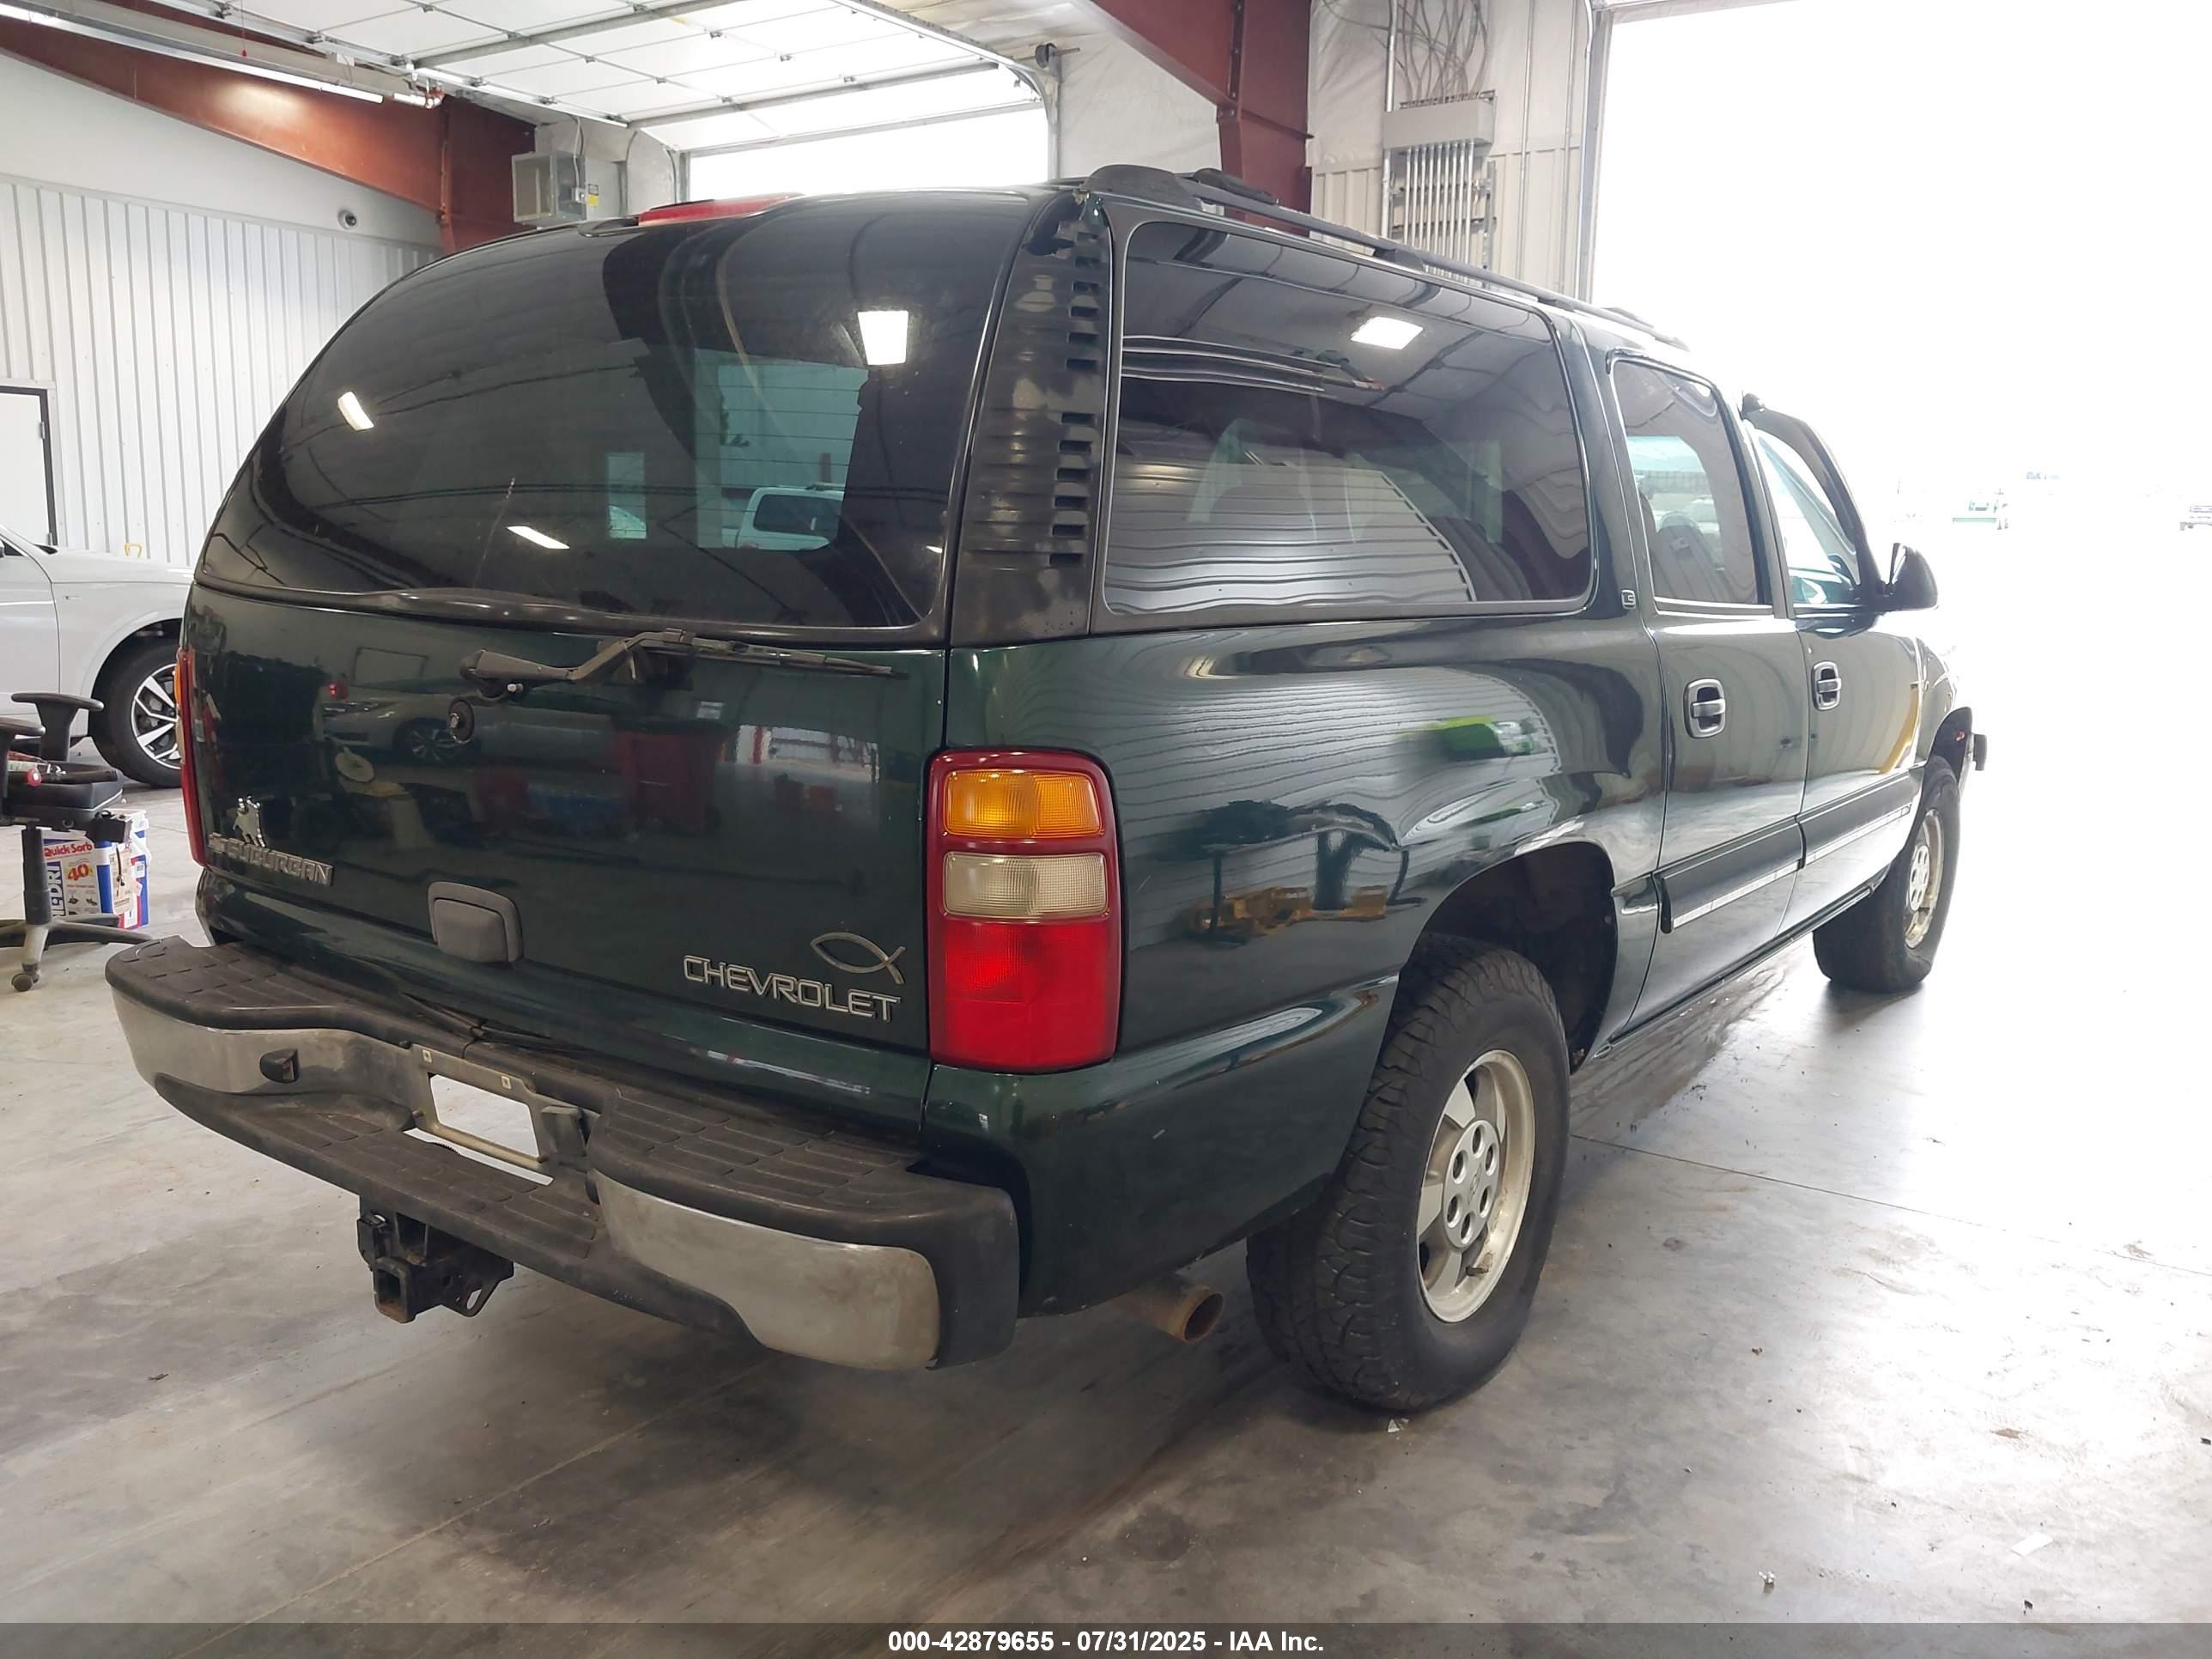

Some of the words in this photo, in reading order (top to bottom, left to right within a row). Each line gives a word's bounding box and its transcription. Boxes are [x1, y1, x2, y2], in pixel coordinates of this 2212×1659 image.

[44, 844, 70, 856] Quick
[71, 842, 93, 854] Sorb
[227, 837, 333, 887] SUBURBAN
[684, 955, 901, 1023] CHEVROLET
